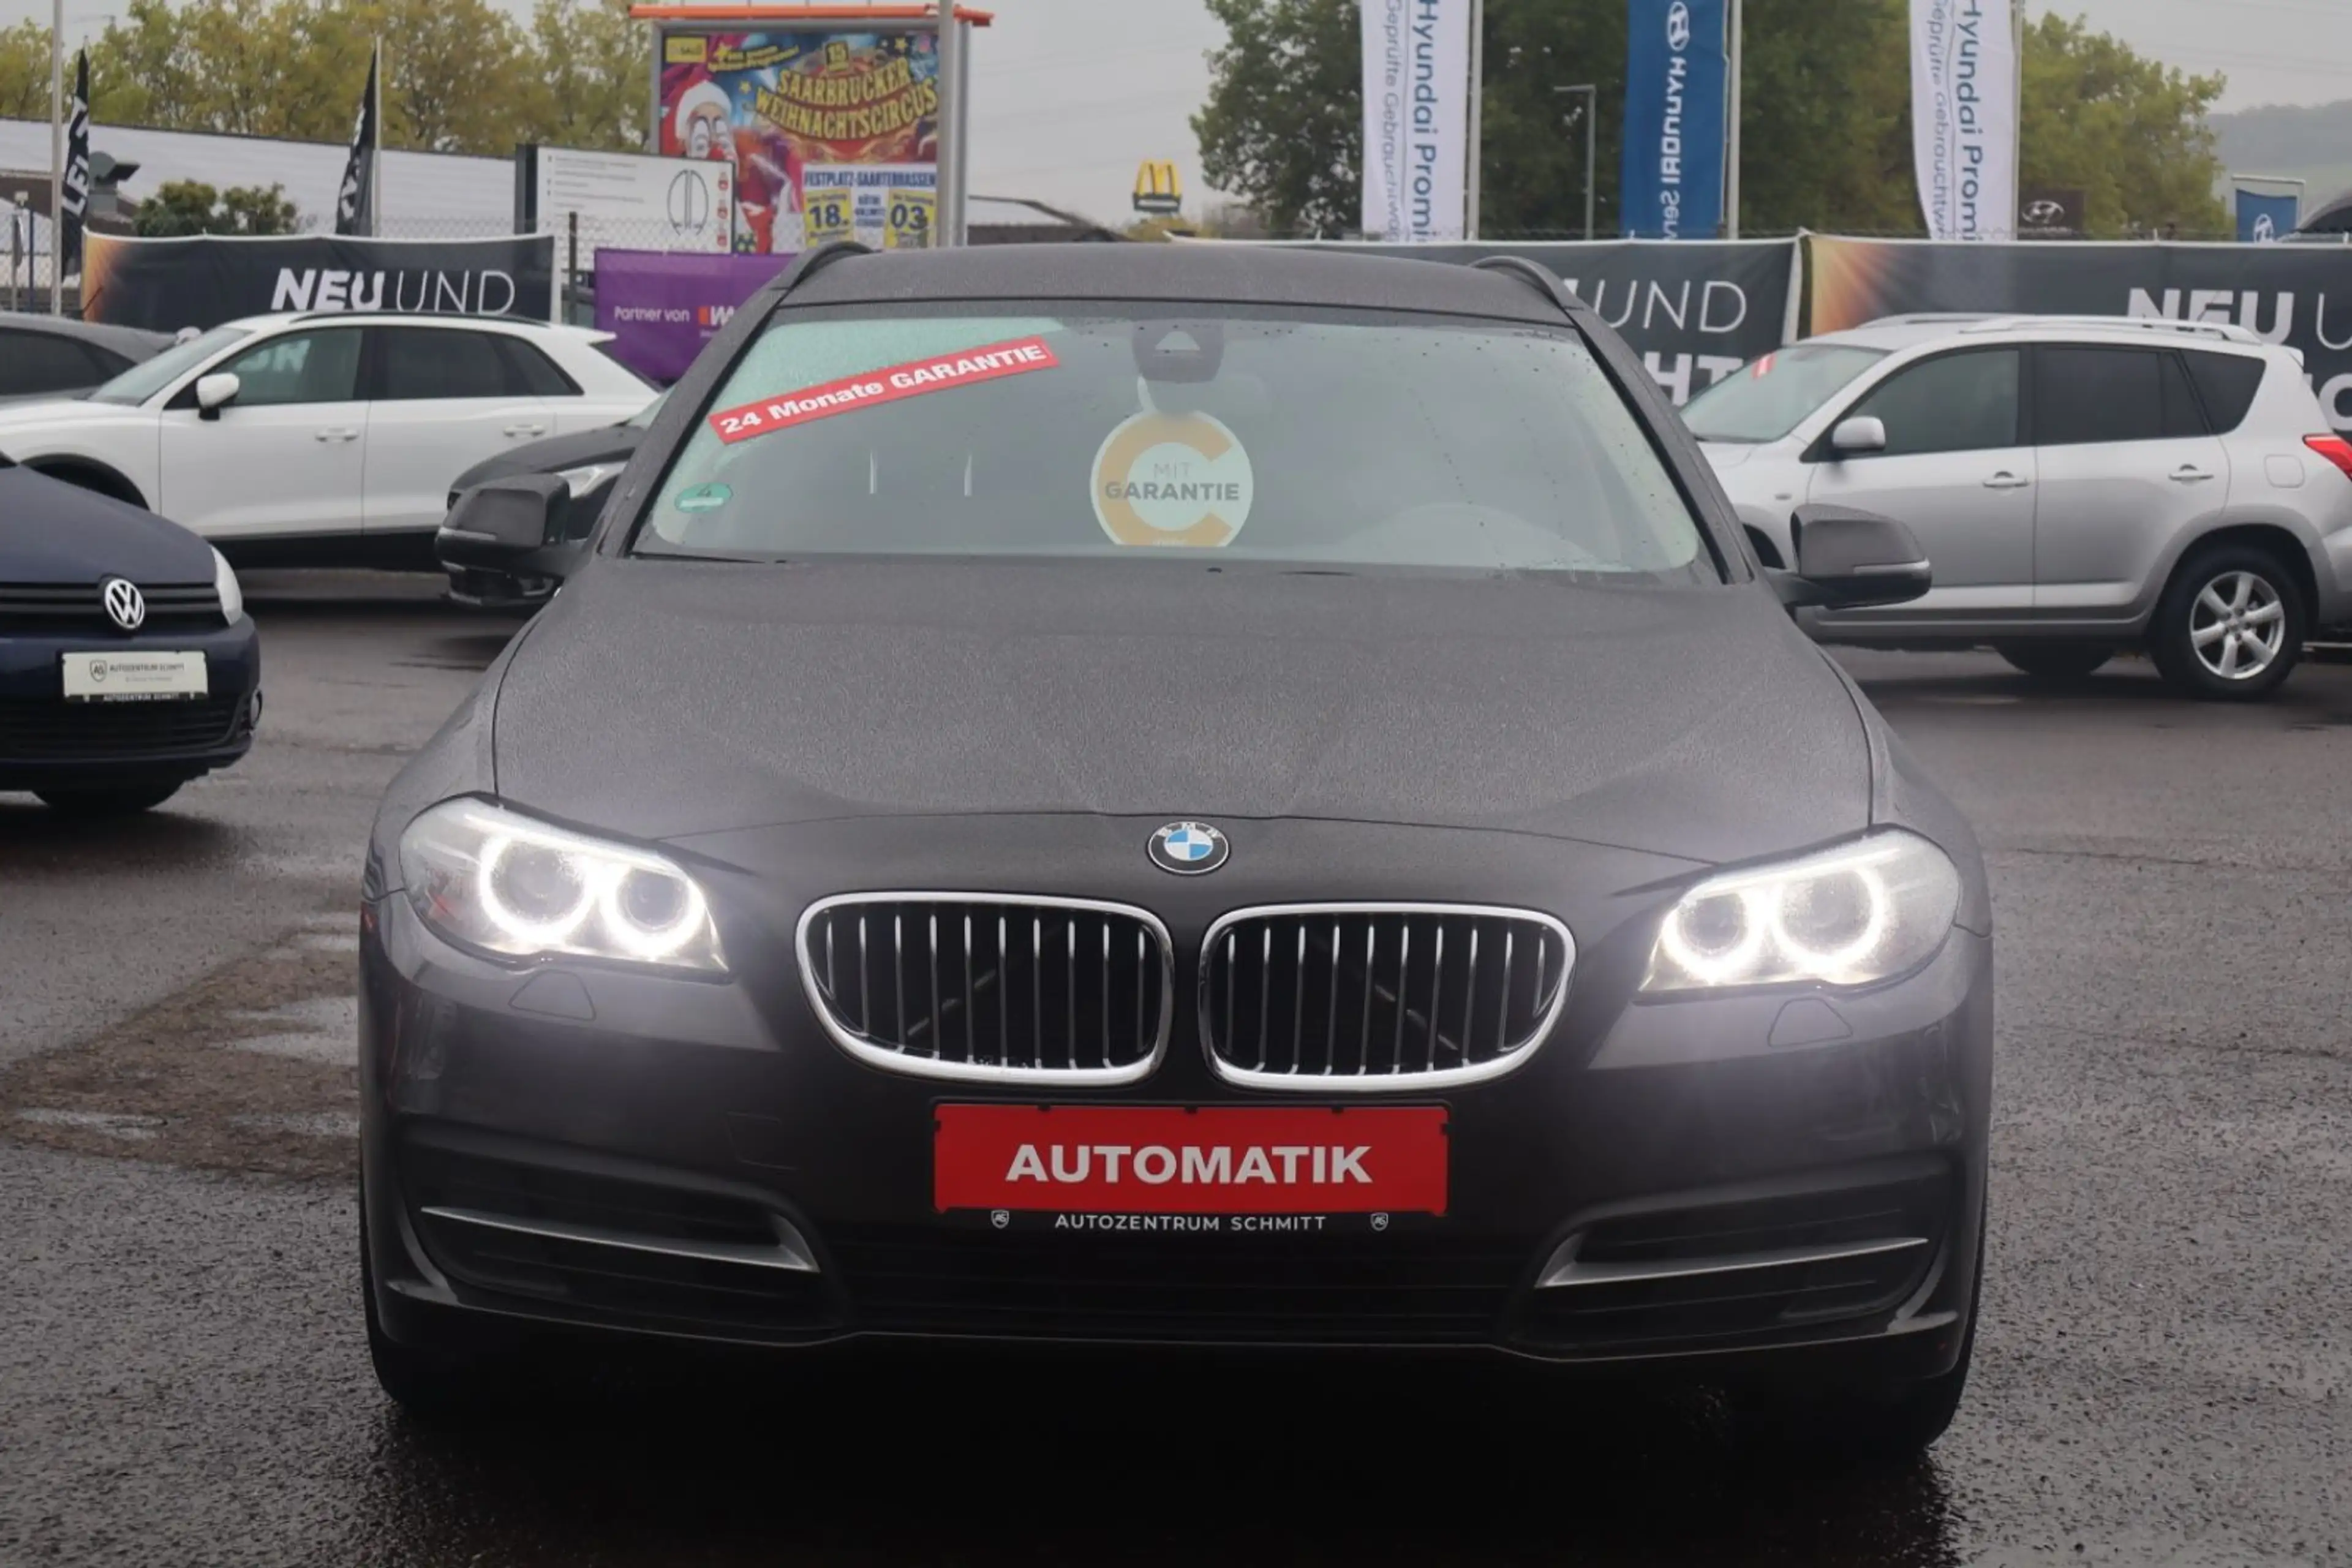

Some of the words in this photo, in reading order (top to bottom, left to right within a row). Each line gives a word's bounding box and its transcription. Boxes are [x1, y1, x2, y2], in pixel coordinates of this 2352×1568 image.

[1412, 0, 1439, 134] Hyundai
[1957, 0, 1983, 134] Hyundai
[755, 77, 938, 140] WEIHNACHTSCIRCUS
[1412, 144, 1439, 243] Promi
[271, 268, 386, 312] NEU
[396, 270, 516, 315] UND
[614, 306, 661, 322] Partner
[664, 311, 690, 322] von
[1594, 279, 1747, 333] UND
[720, 413, 763, 434] 24
[767, 380, 885, 421] Monate
[889, 344, 1048, 390] GARANTIE
[1105, 481, 1240, 501] GARANTIE
[1154, 462, 1192, 479] MIT
[1005, 1144, 1373, 1183] AUTOMATIK
[1055, 1214, 1219, 1231] AUTOZENTRUM
[1231, 1216, 1326, 1231] SCHMITT
